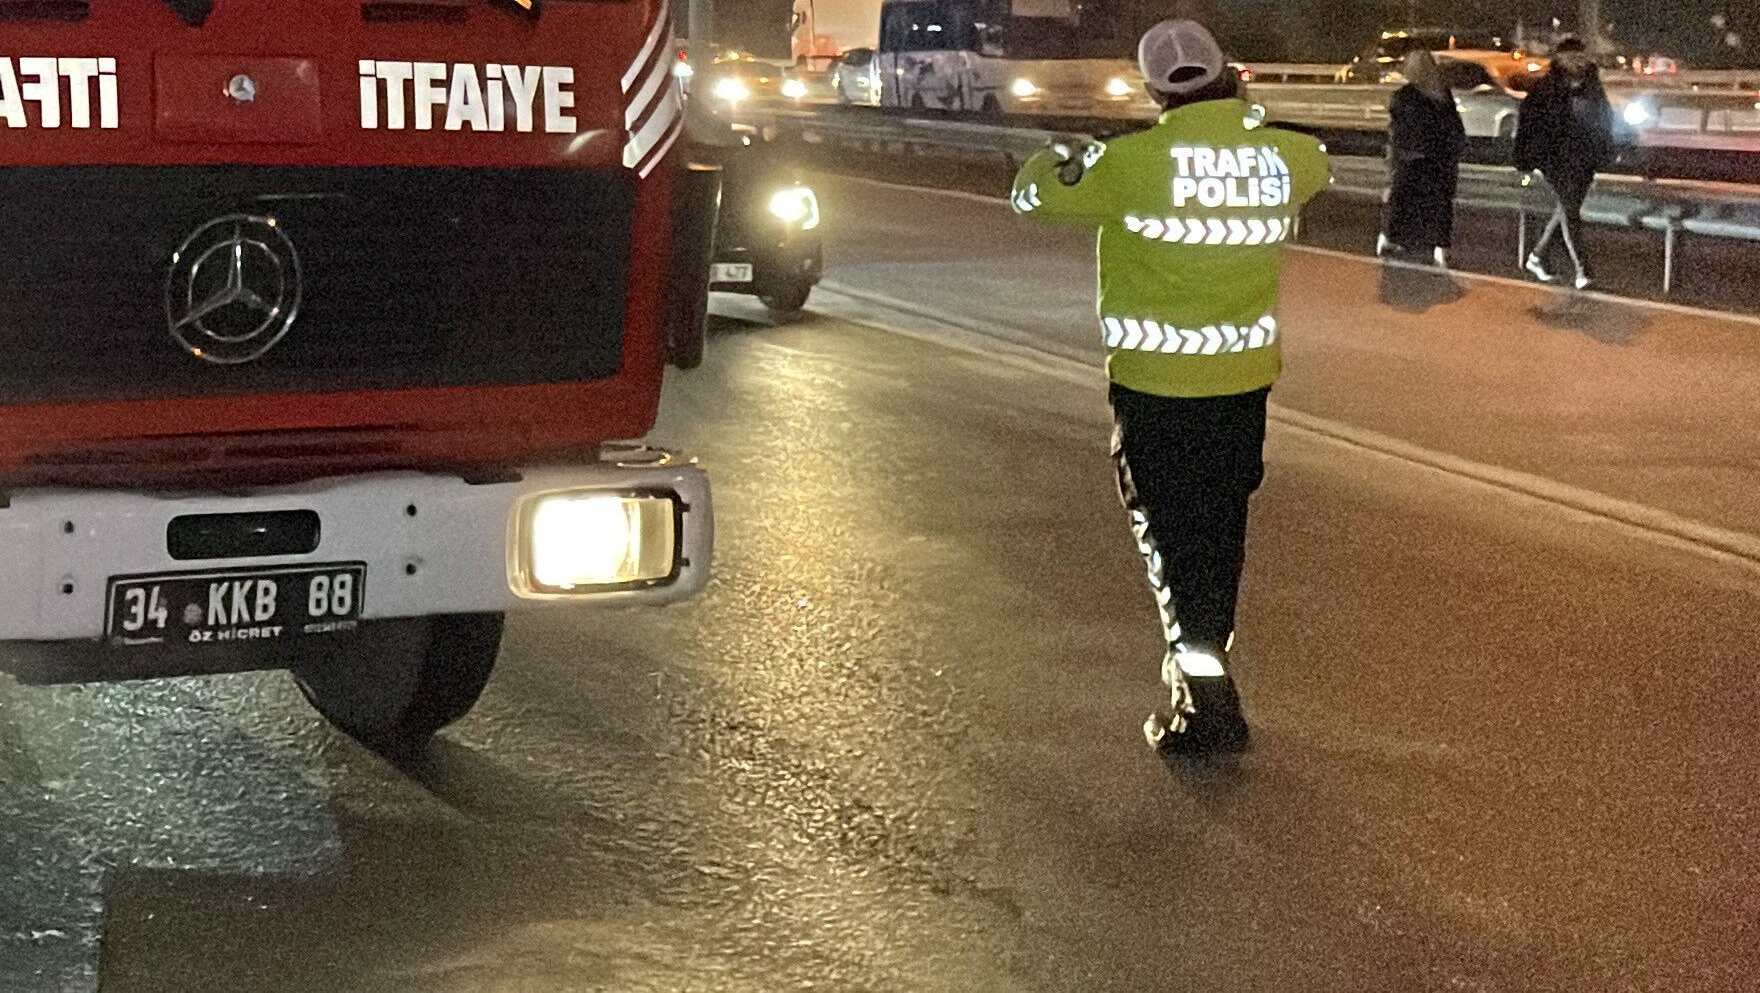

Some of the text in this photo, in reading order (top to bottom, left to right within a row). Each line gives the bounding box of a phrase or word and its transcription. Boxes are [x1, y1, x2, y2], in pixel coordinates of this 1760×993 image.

[122, 573, 354, 631] 34 KKB 88
